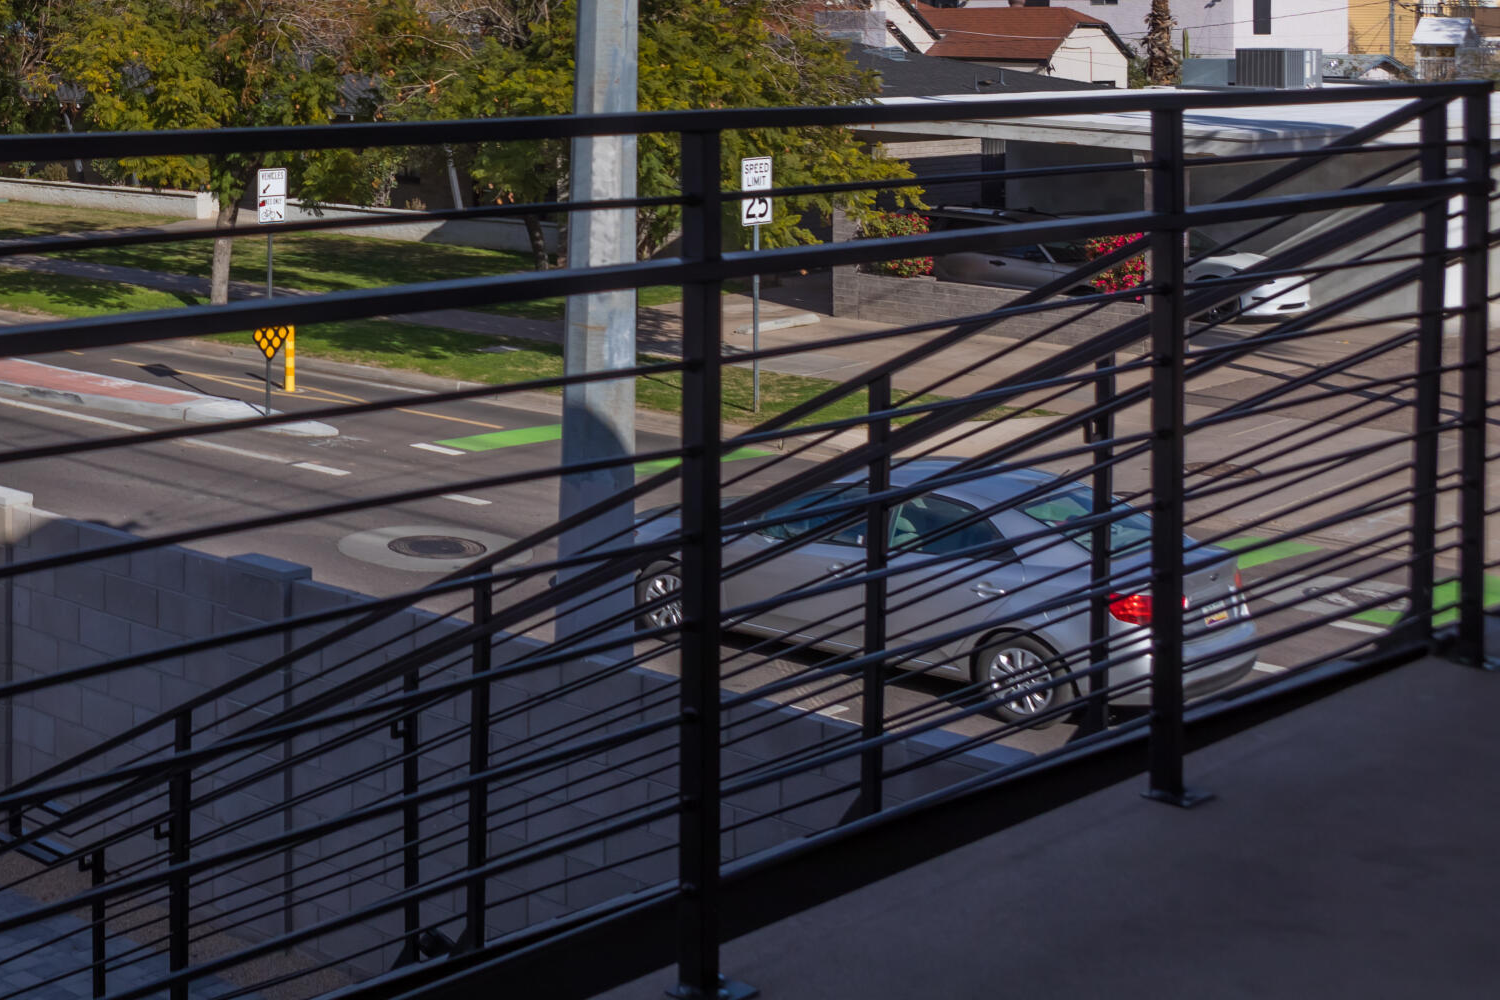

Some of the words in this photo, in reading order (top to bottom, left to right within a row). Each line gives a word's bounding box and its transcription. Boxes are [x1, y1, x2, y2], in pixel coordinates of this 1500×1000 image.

[744, 162, 770, 175] SPEED
[261, 171, 284, 180] VEHICLES
[747, 175, 766, 187] LIMIT
[746, 197, 769, 219] 25
